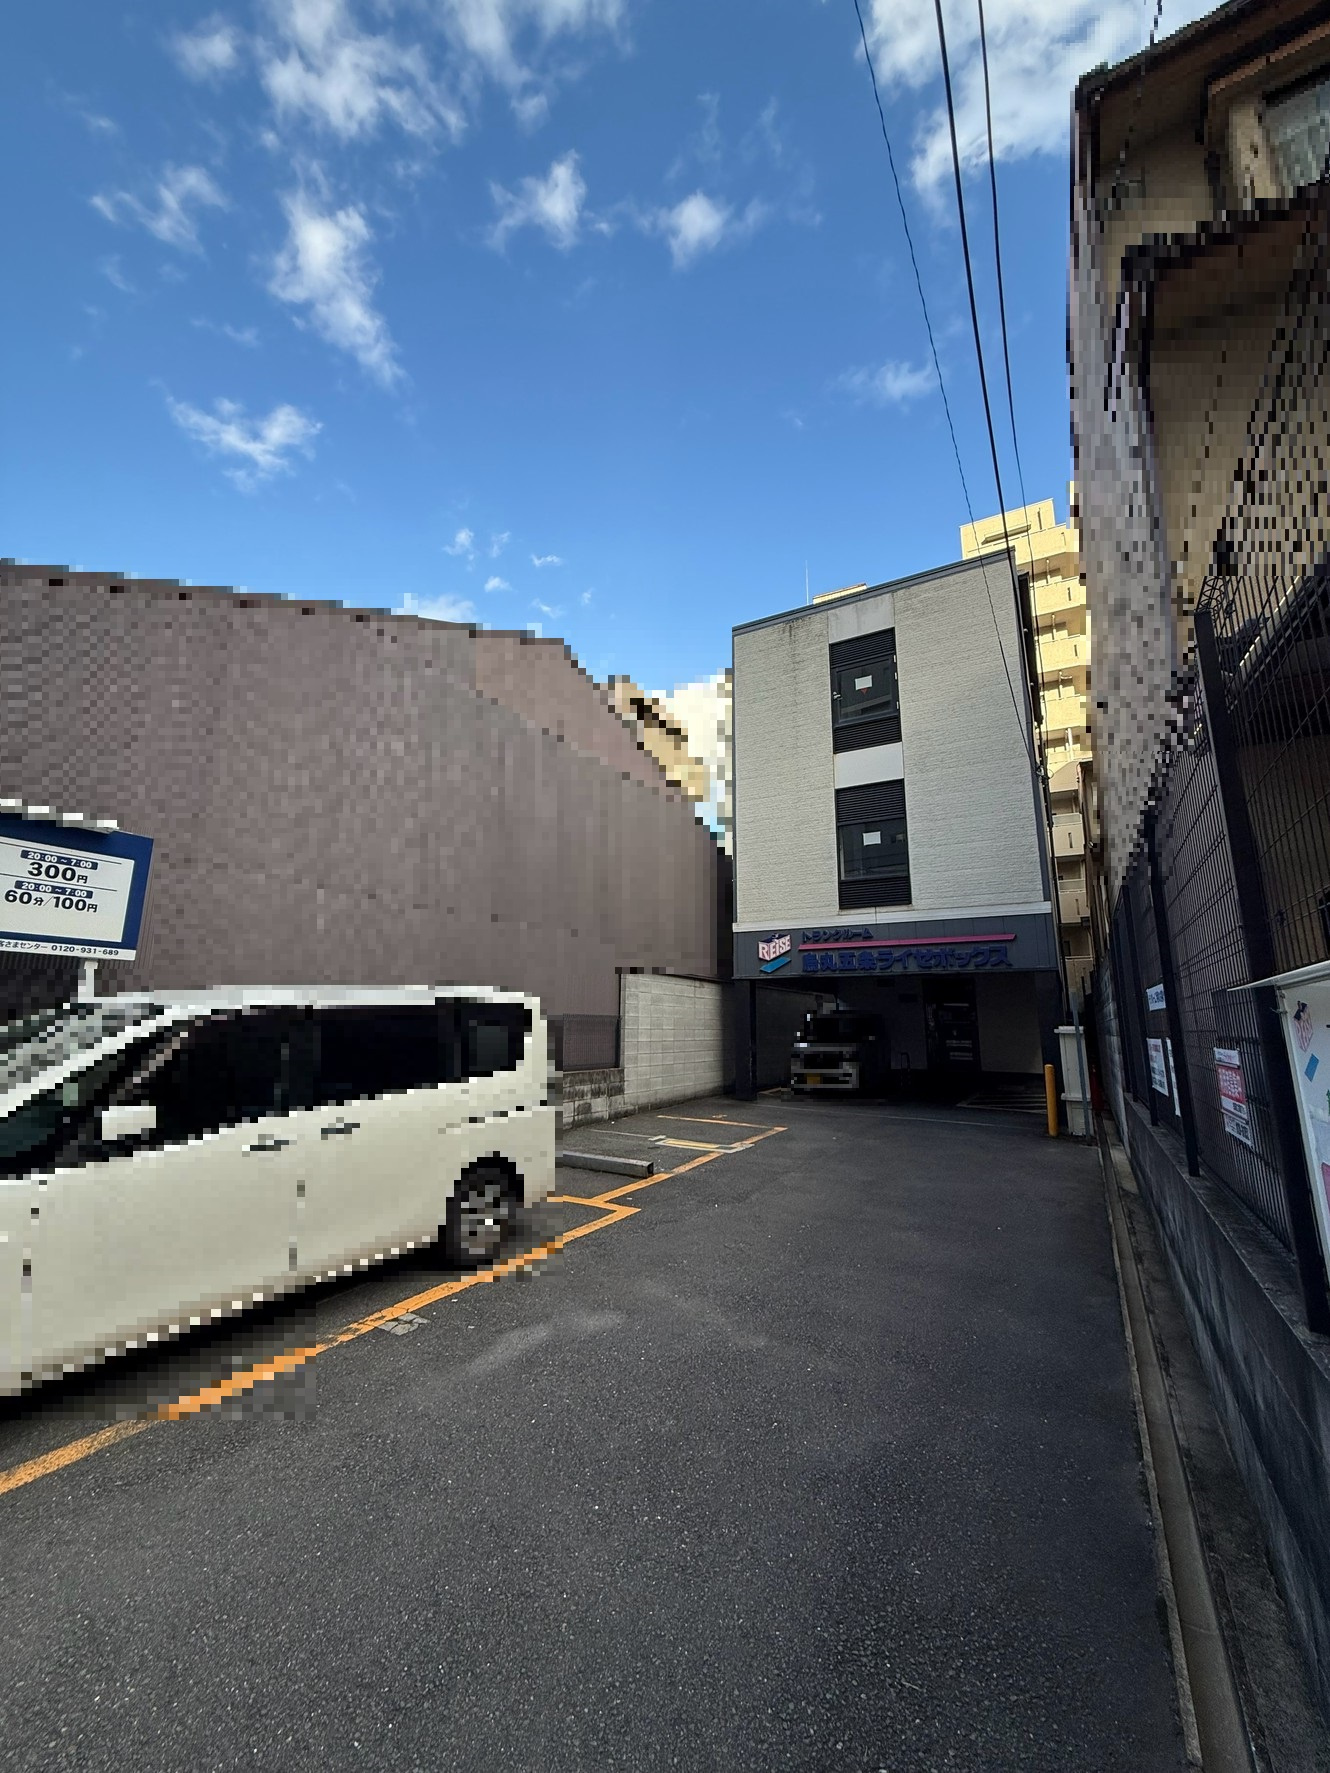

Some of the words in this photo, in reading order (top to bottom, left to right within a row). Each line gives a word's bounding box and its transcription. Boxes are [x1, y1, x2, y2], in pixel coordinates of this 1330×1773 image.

[27, 861, 89, 884] 300円
[802, 928, 874, 943] トランクルーム
[51, 944, 119, 956] 0120-931-689
